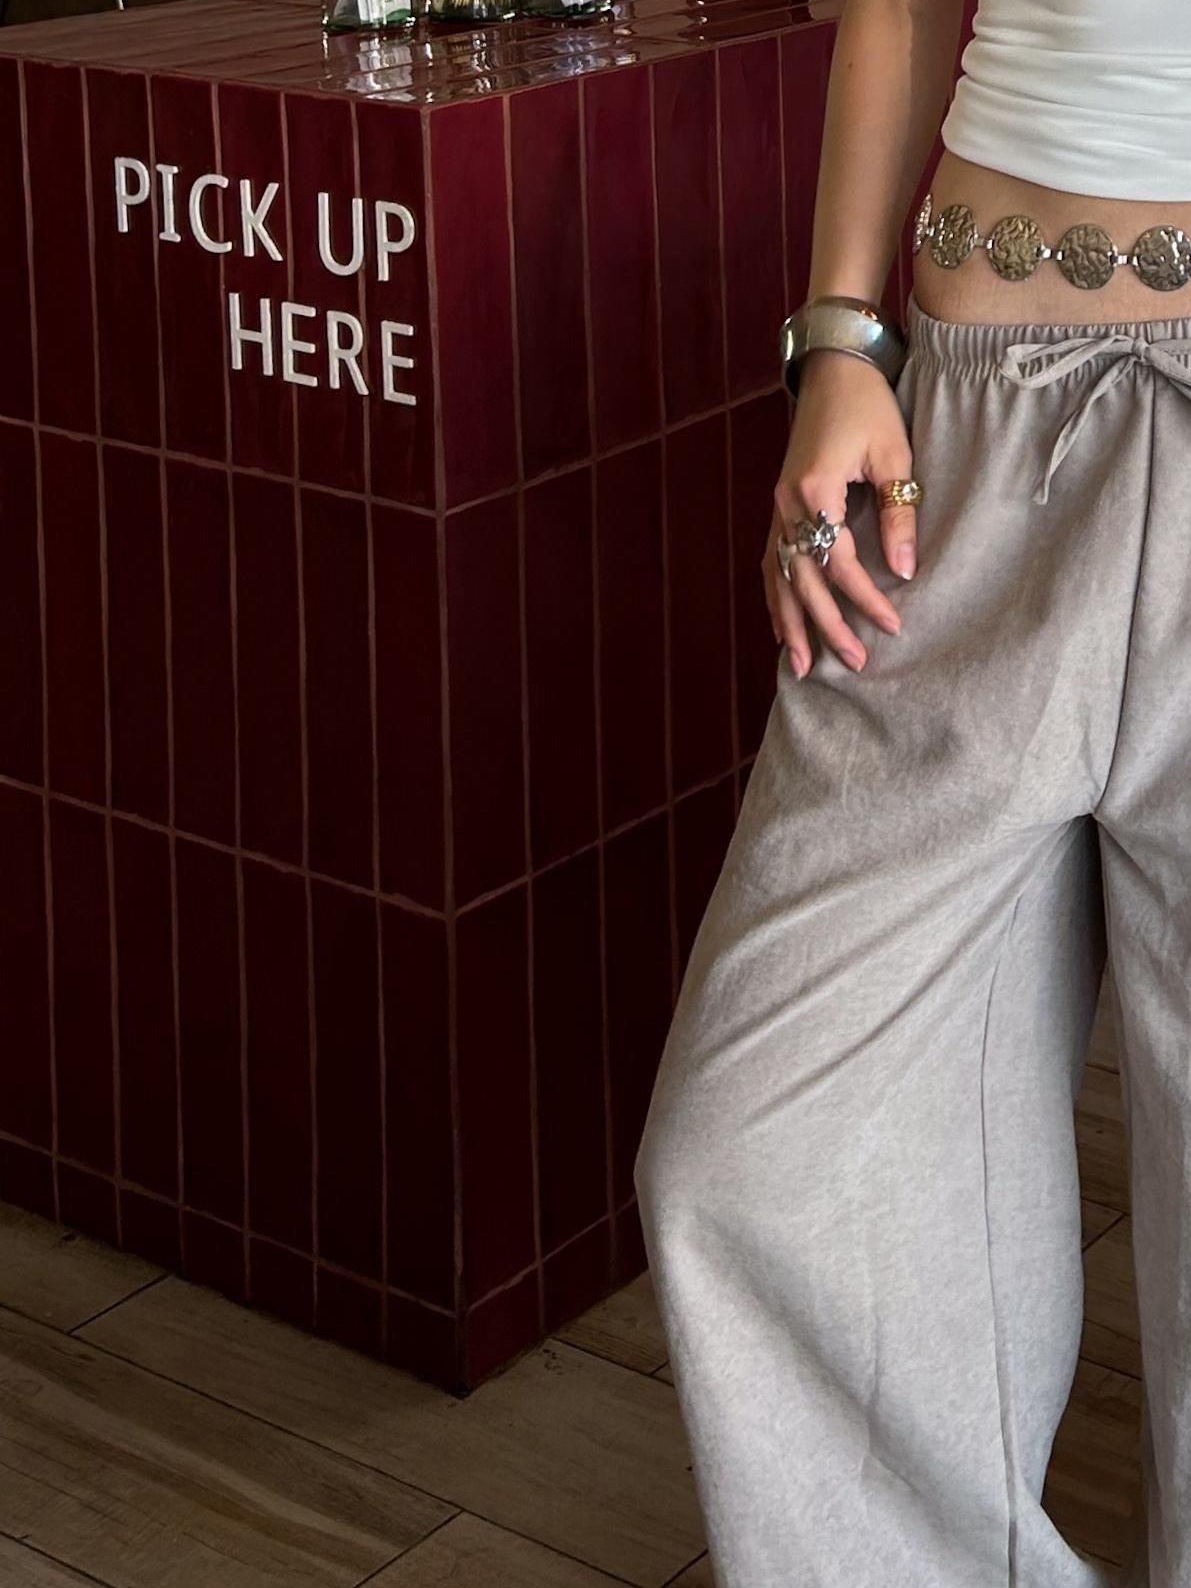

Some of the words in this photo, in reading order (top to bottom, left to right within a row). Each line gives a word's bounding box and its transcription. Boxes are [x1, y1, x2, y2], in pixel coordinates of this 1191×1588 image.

[114, 156, 283, 261] PICK
[318, 192, 416, 282] UP
[228, 292, 417, 406] HERE
